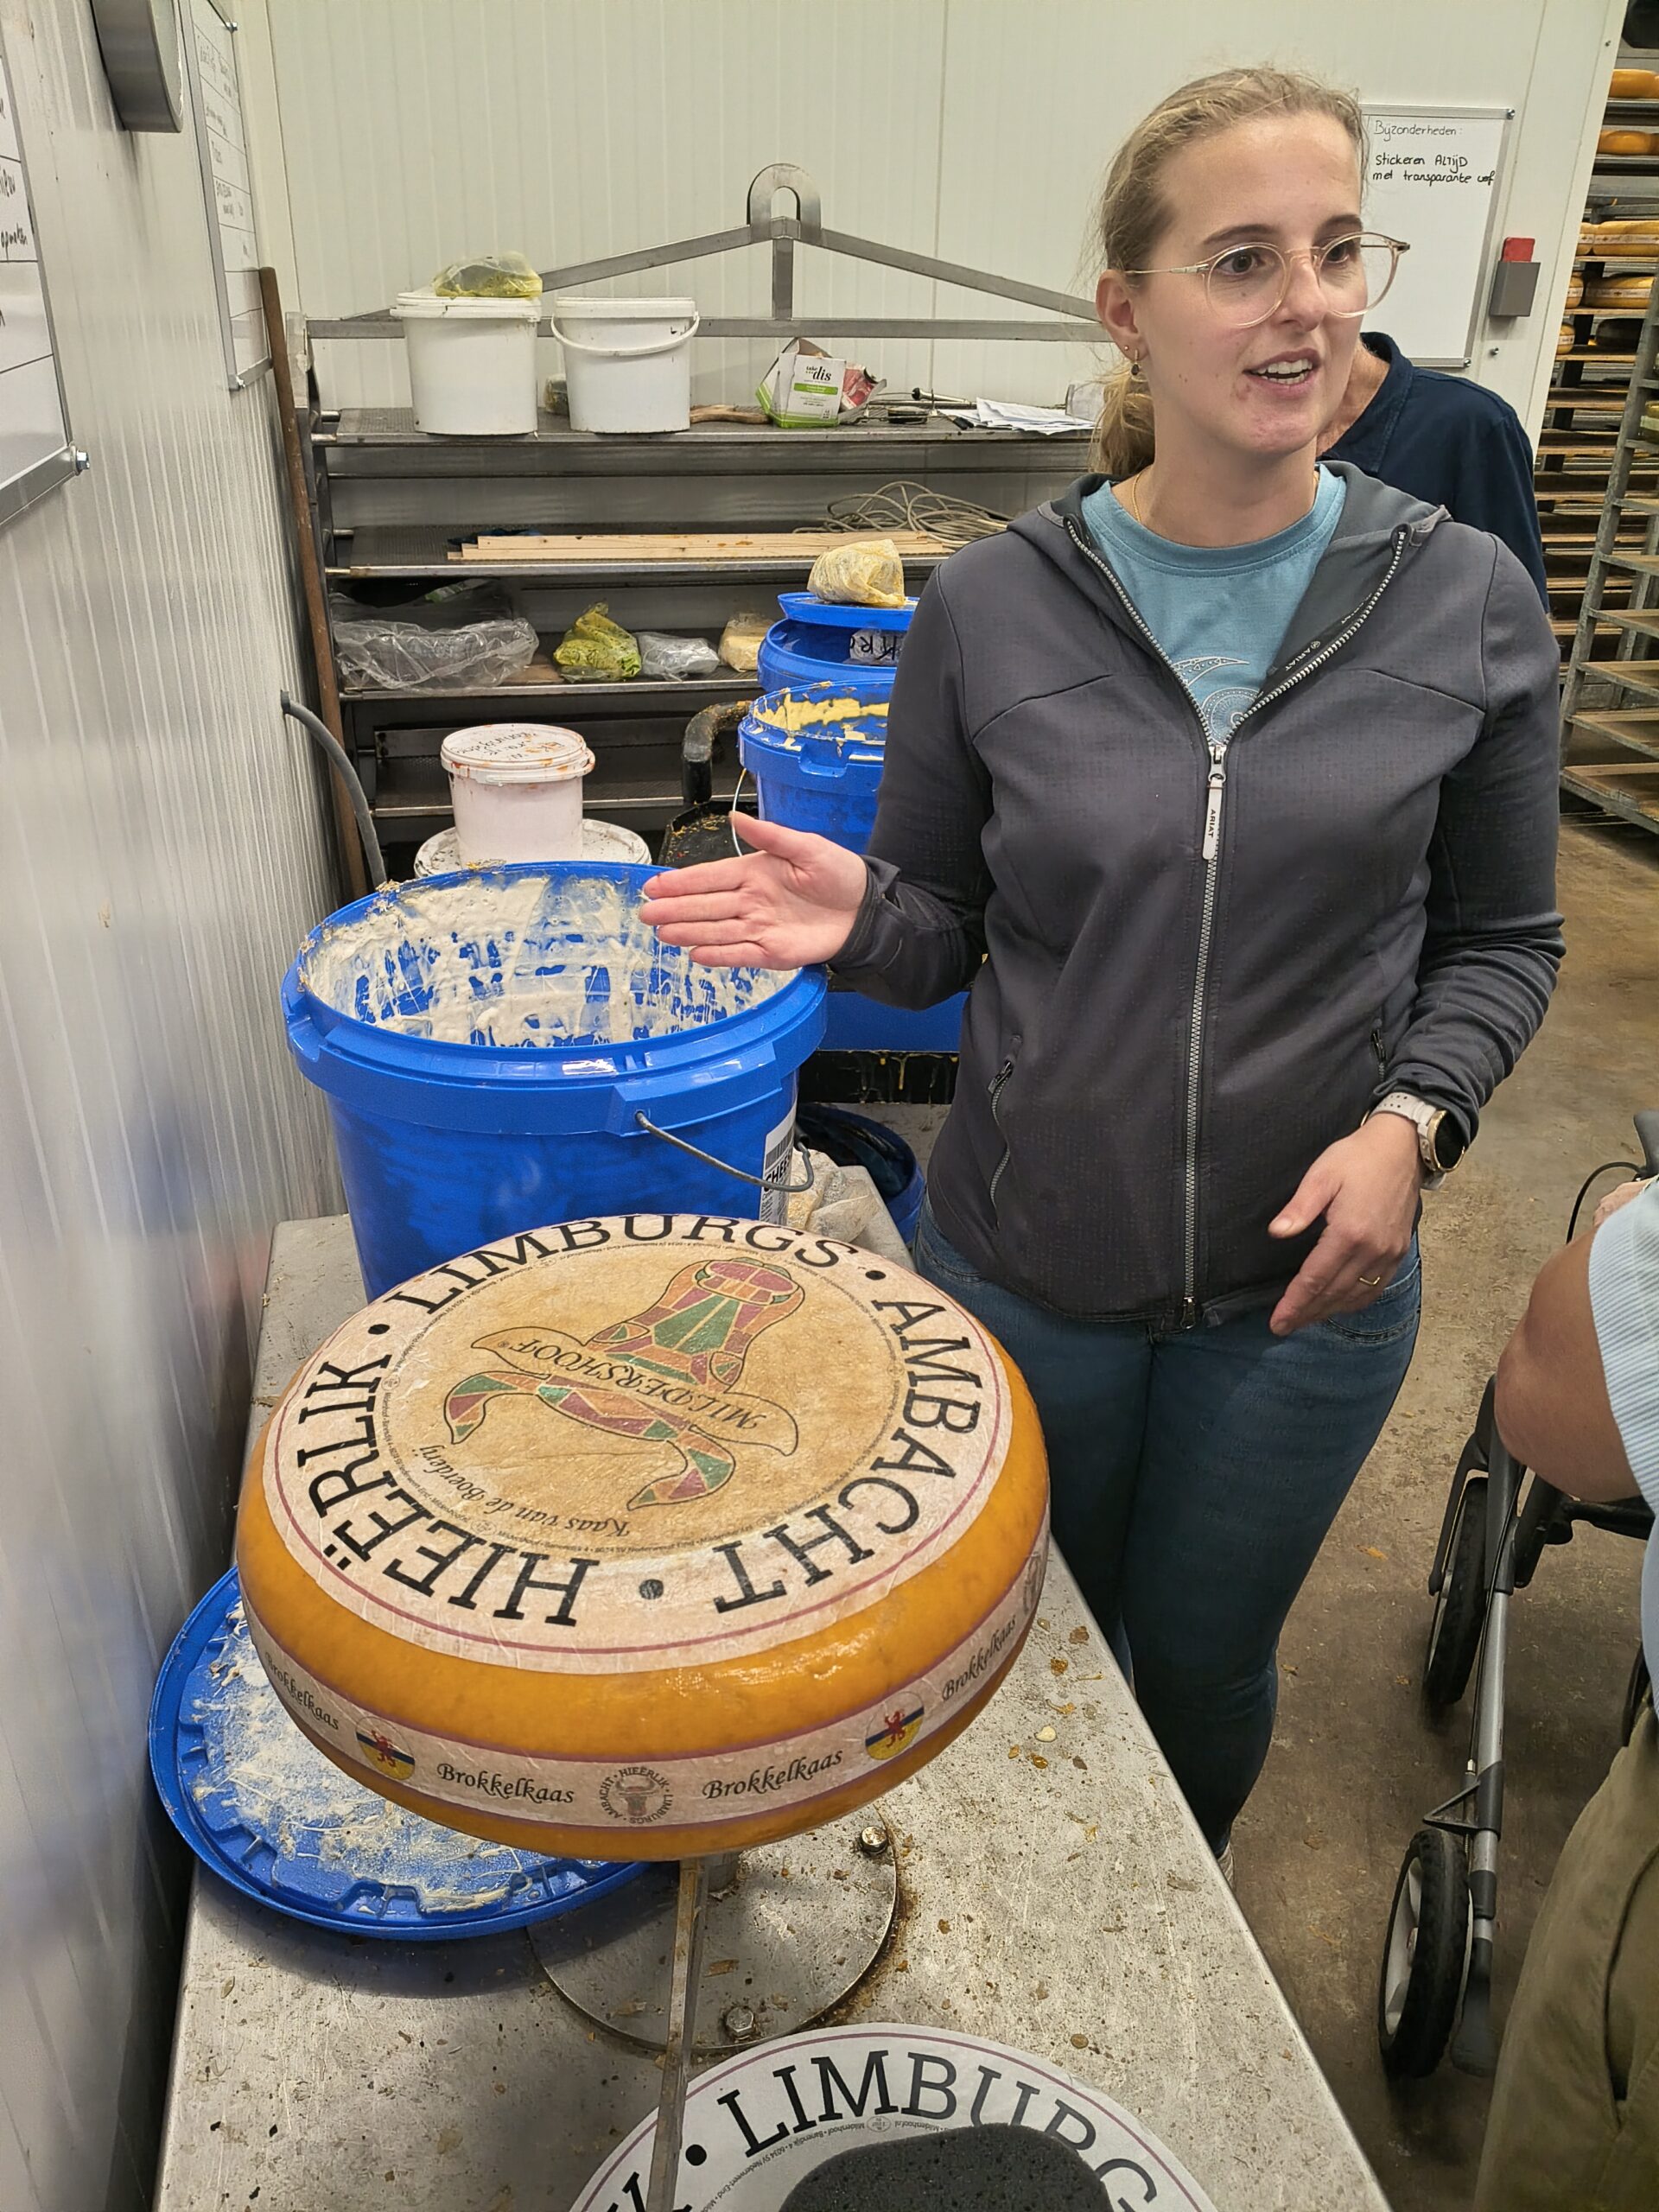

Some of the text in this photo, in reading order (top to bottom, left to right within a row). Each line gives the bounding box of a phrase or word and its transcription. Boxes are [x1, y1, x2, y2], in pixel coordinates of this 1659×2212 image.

[1372, 169, 1393, 181] met
[1403, 170, 1471, 187] transparante
[1376, 152, 1425, 166] Stickeren
[1208, 809, 1217, 838] ARIAT
[384, 1214, 858, 1315] LIMBURGS
[509, 1338, 767, 1431] MILDERSHOOF
[713, 1299, 983, 1613] AMBACHT
[297, 1354, 601, 1627] HIEËRLIK
[411, 1446, 631, 1537] Kaas van de Boerderij
[941, 1615, 1018, 1701] Brokkelkaas
[264, 1651, 340, 1731] Brokkelkaas
[436, 1763, 575, 1804] Brokkelkaas
[599, 1777, 623, 1818] AMBACHT
[702, 1751, 843, 1800] Brokkelkaas
[769, 2145, 786, 2159] 6034
[828, 2122, 865, 2137] Mildershoof
